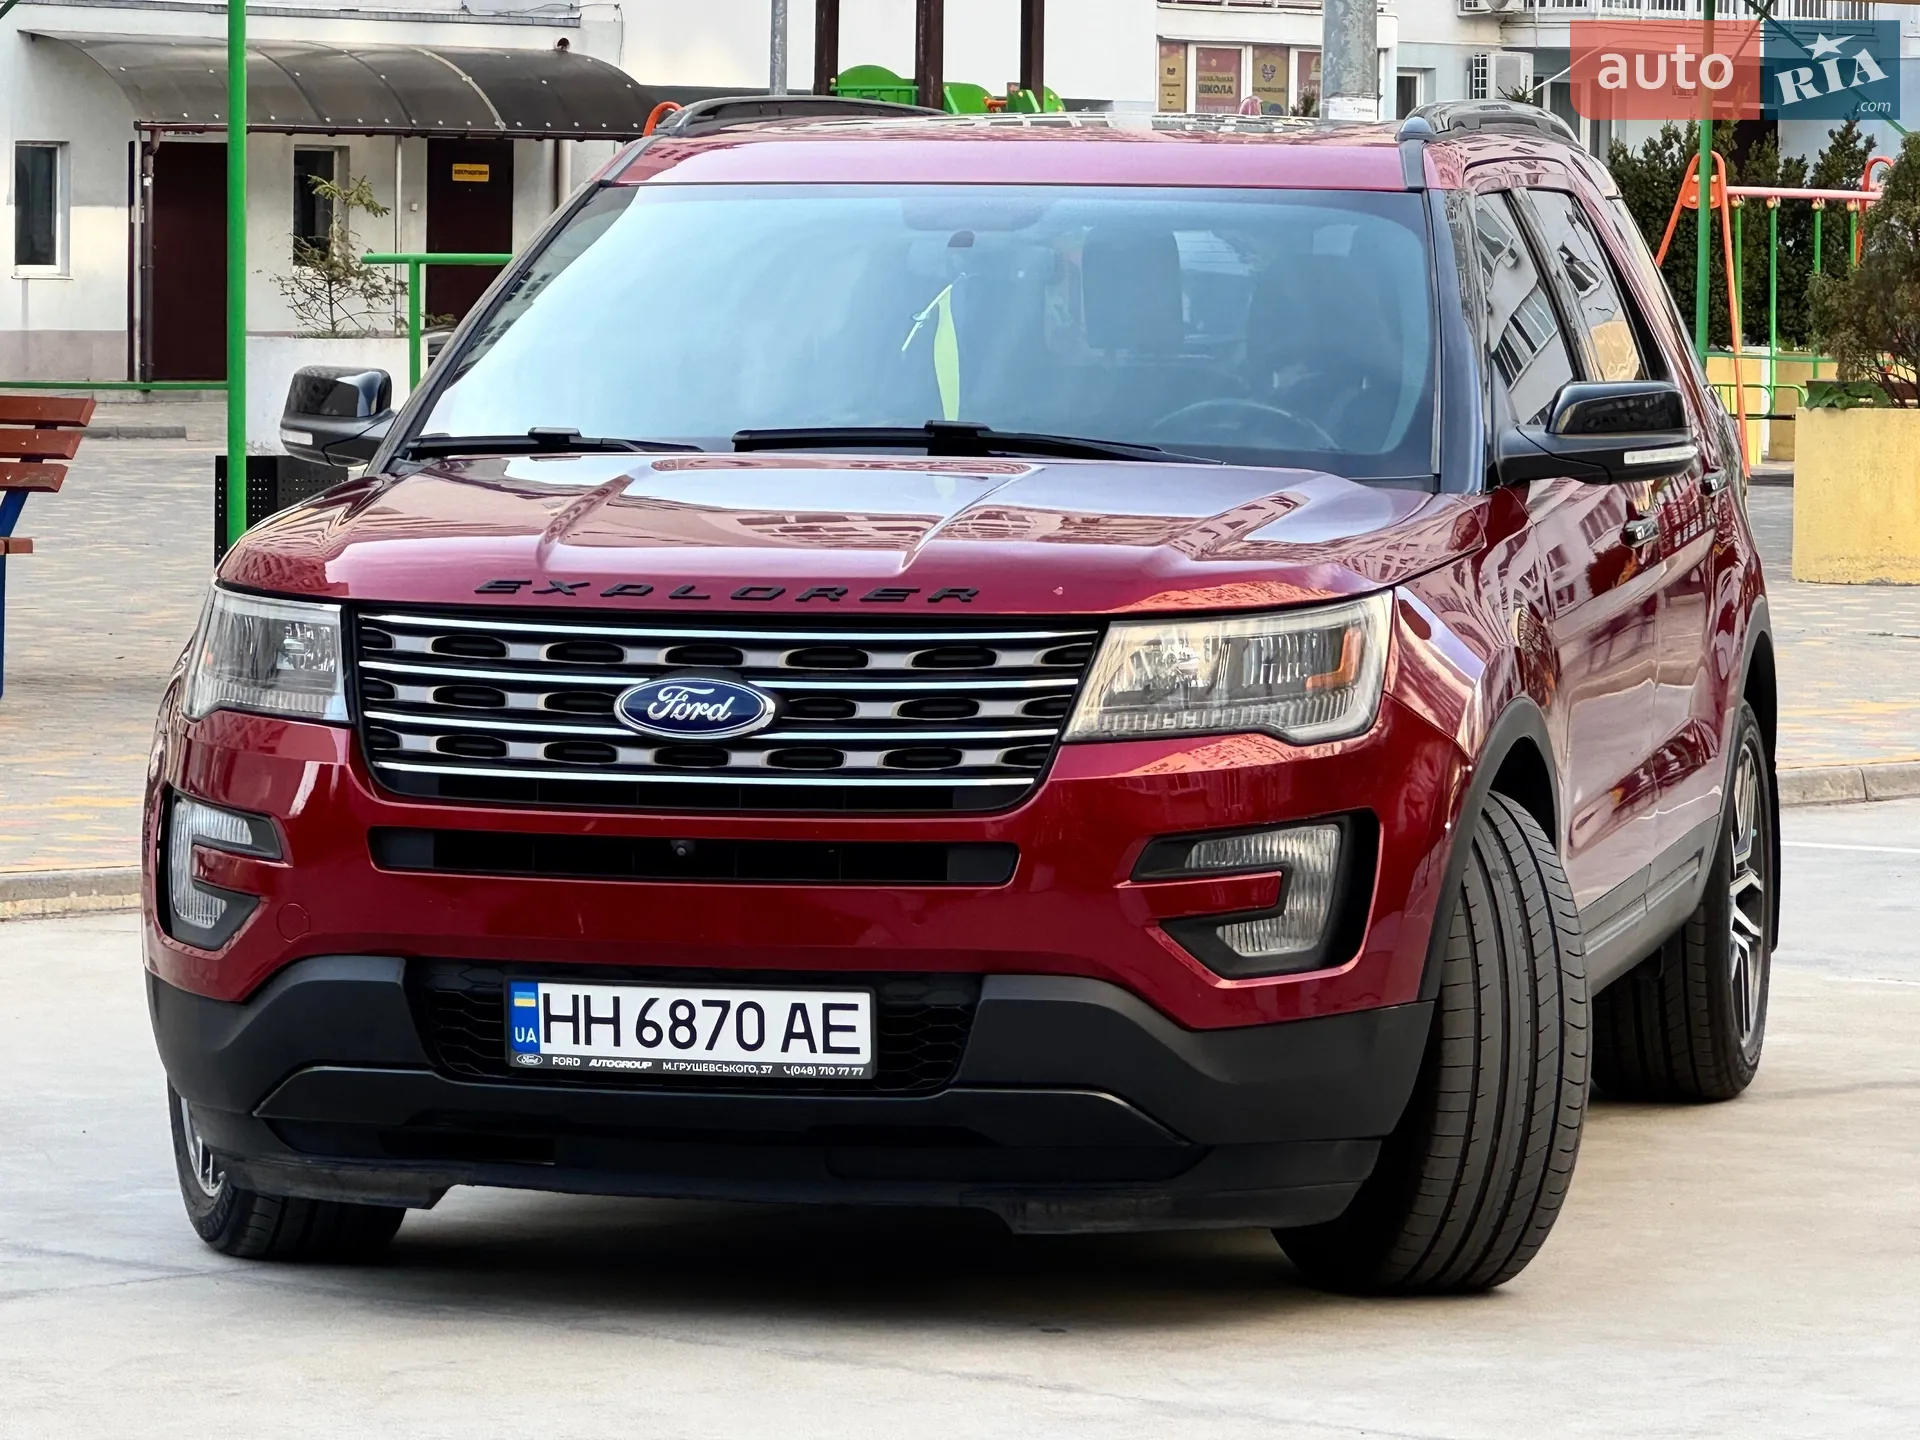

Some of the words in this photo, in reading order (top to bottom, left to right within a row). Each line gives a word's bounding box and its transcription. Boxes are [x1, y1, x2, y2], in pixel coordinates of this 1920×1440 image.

[1198, 84, 1233, 94] ШКОЛА
[474, 578, 982, 604] EXPLORER
[647, 685, 736, 723] Ford
[543, 992, 621, 1047] HH
[635, 997, 766, 1052] 6870
[780, 1002, 861, 1055] AE
[514, 1027, 538, 1043] UA
[552, 1056, 581, 1067] FORD
[588, 1058, 653, 1069] AUTOGROUP
[760, 1065, 773, 1074] 37
[790, 1065, 817, 1076] (048)
[819, 1066, 835, 1076] 710
[837, 1066, 850, 1076] 77
[851, 1066, 864, 1076] 77
